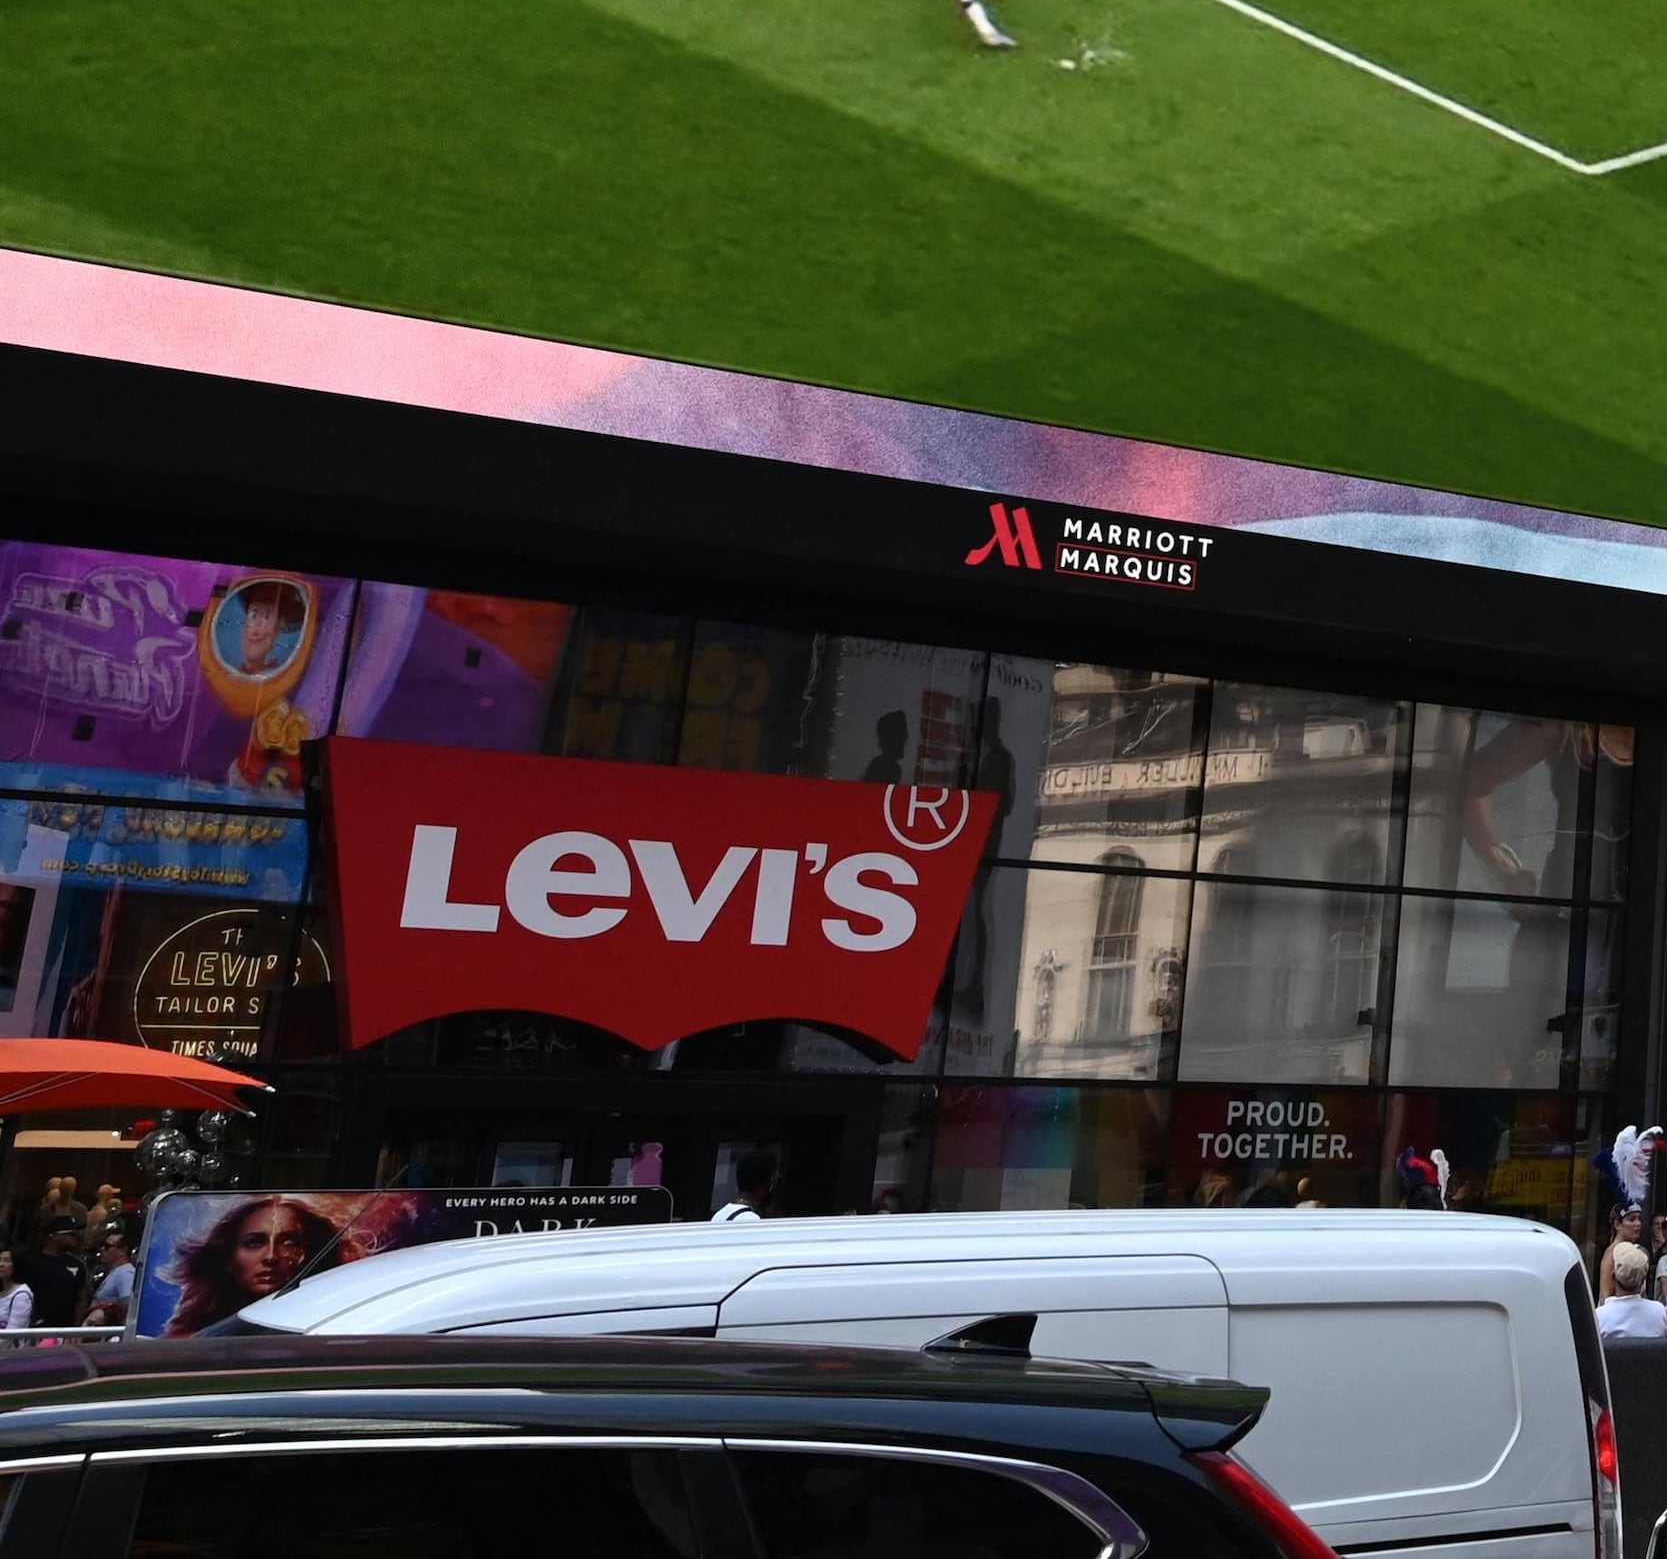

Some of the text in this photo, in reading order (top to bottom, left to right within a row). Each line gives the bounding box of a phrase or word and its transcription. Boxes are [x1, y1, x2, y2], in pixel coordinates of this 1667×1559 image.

[1063, 518, 1214, 558] MARRIOTT
[1060, 548, 1193, 586] MARQUIS
[155, 996, 236, 1014] TAILOR
[171, 1040, 216, 1057] TIMES
[1226, 1100, 1331, 1128] PROUD.
[1197, 1132, 1353, 1160] TOGETHER.
[446, 1194, 639, 1208] EVERY HERO HAS A DARK SIDE
